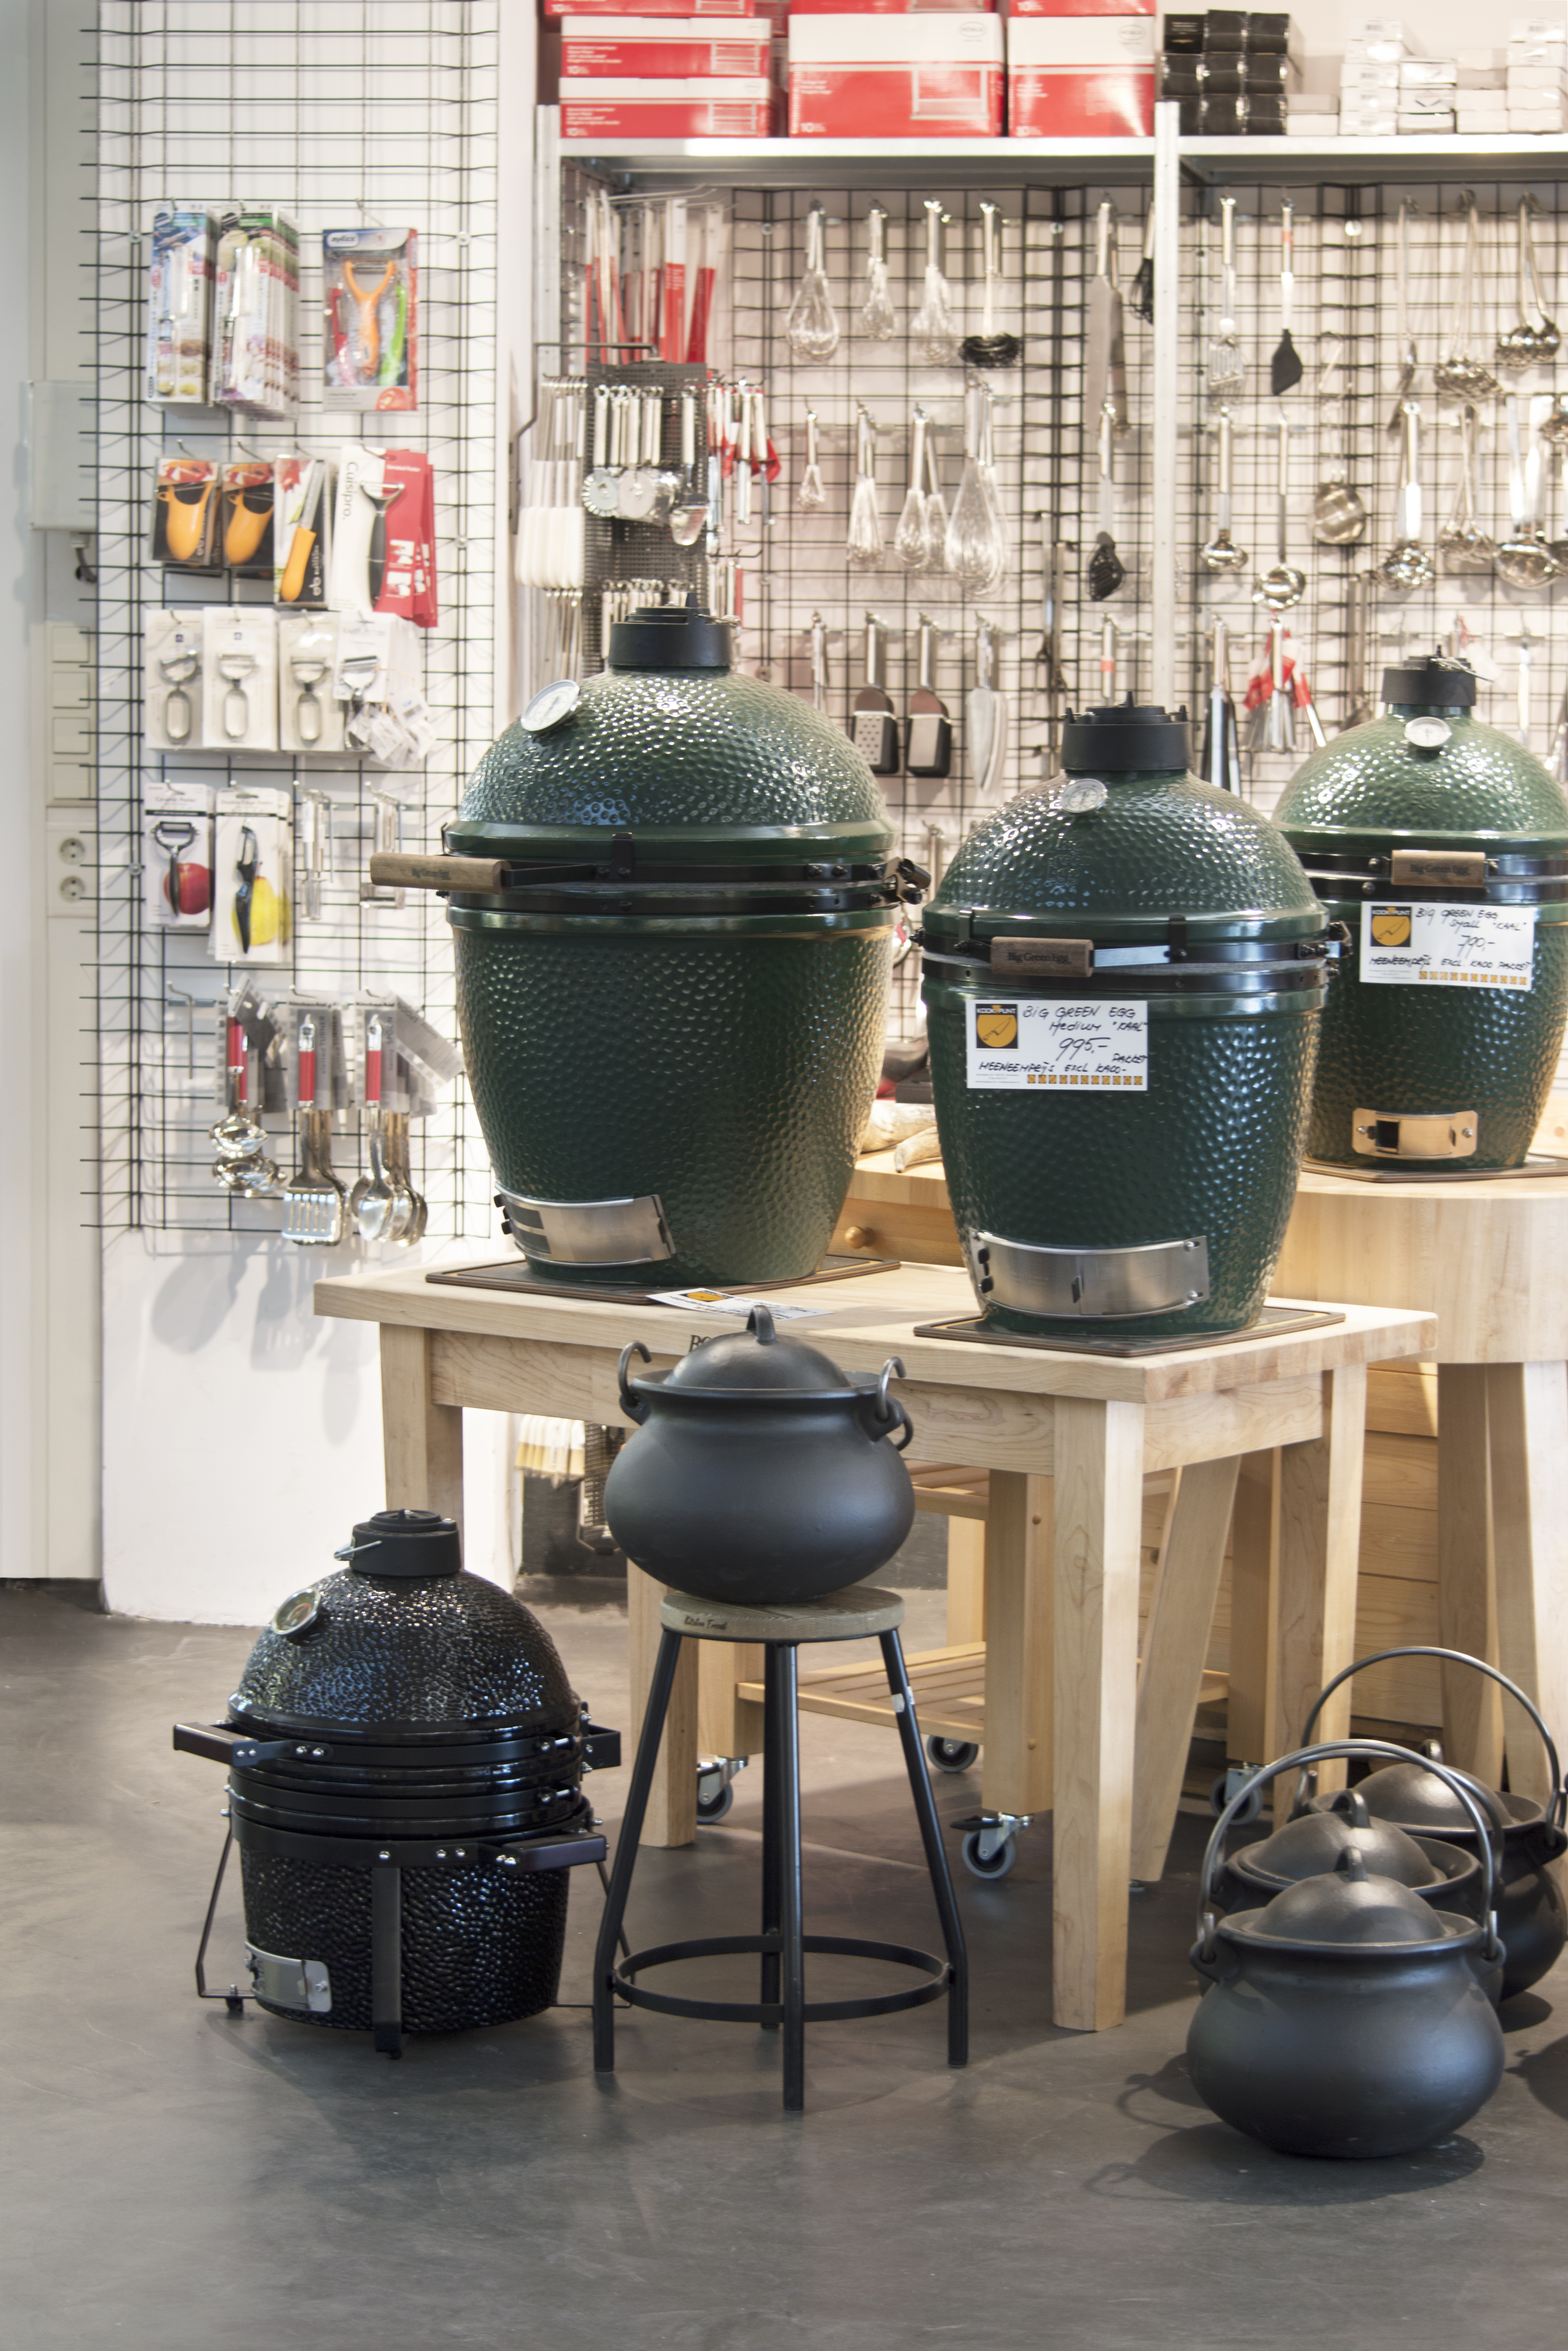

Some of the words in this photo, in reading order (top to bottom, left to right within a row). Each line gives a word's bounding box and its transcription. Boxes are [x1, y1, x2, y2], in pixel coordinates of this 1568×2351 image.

[1008, 952, 1023, 963] Big
[1024, 952, 1051, 961] Green
[1055, 1005, 1101, 1022] GREEN
[1108, 1006, 1136, 1018] EGG
